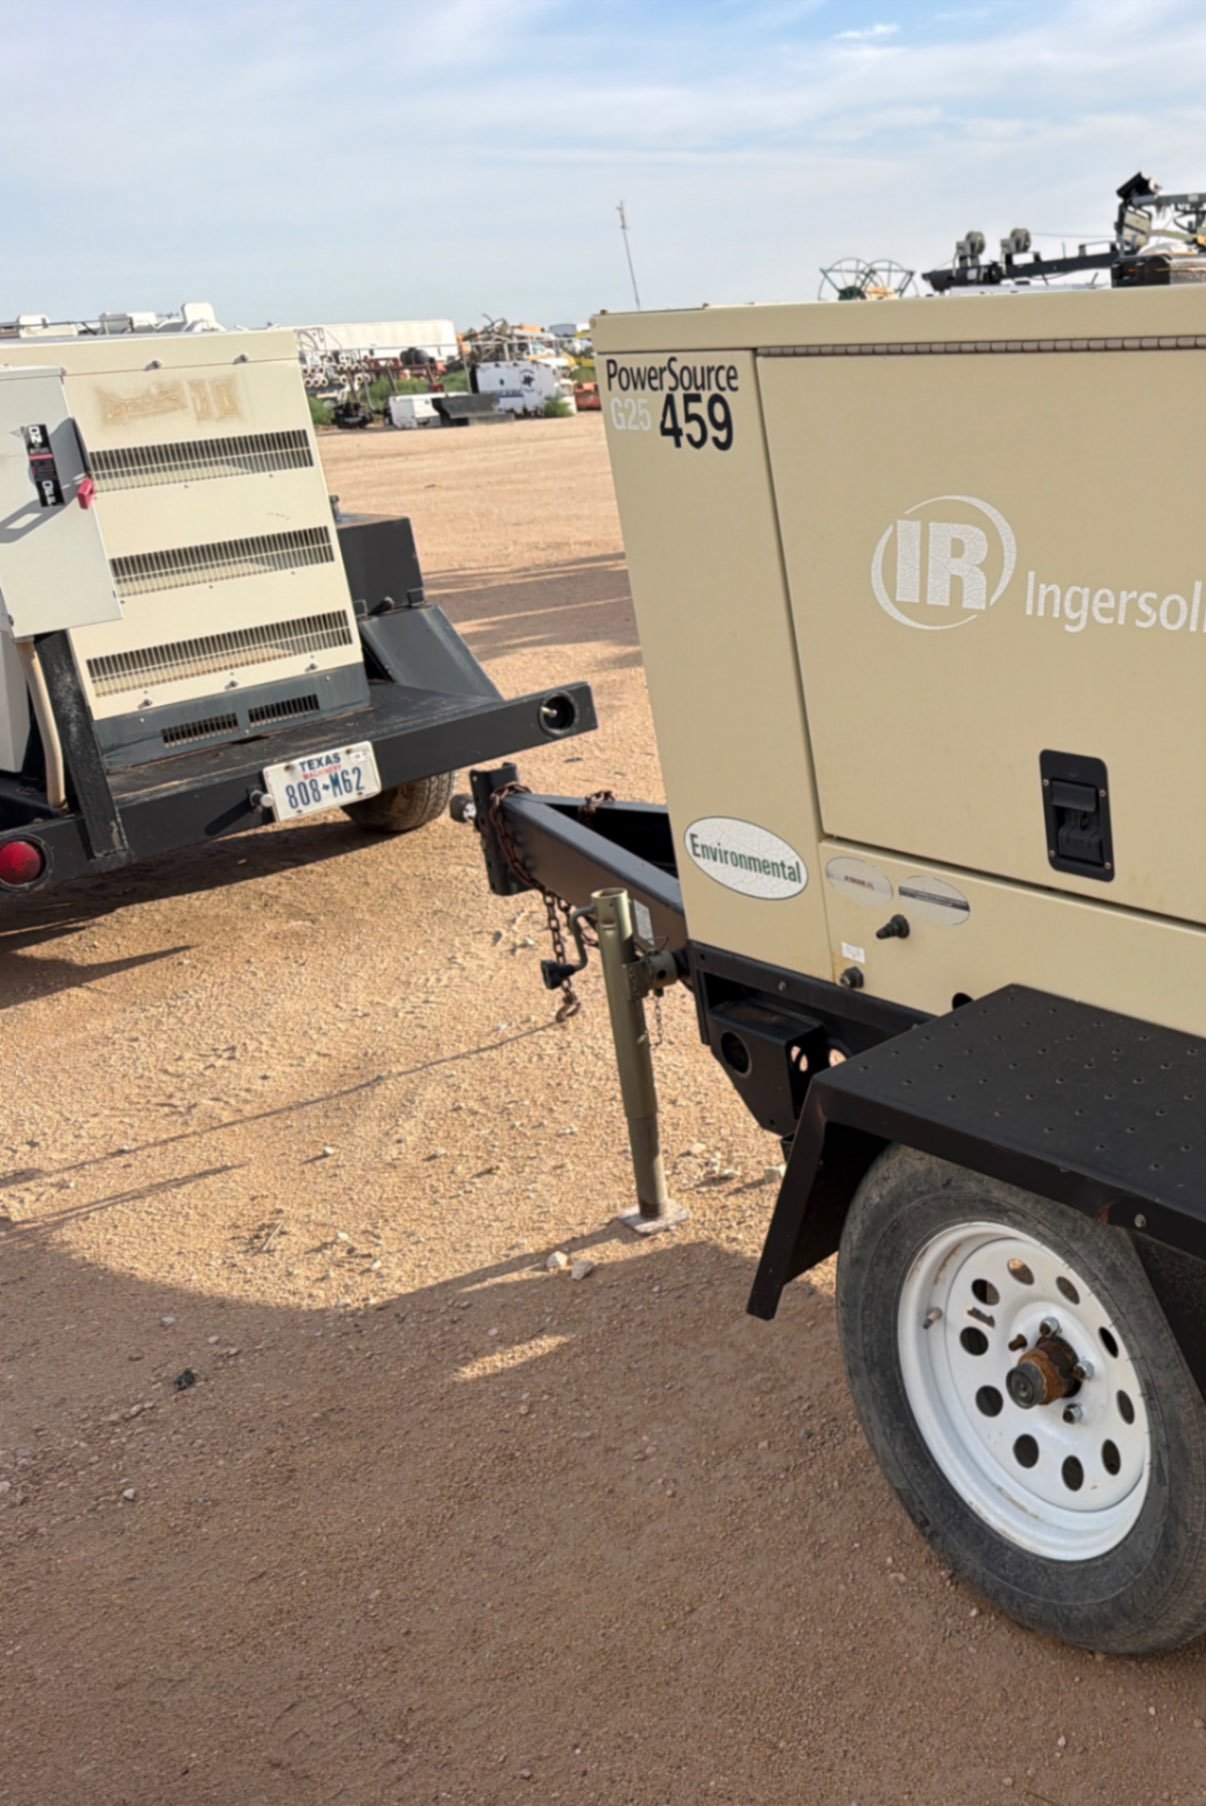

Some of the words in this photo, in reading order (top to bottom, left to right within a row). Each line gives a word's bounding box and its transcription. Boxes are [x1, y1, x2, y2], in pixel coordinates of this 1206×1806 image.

[605, 356, 739, 392] PowerSource
[610, 396, 652, 431] G25
[659, 392, 733, 451] 459
[895, 519, 988, 611] IR
[299, 753, 342, 772] TEXAS
[689, 833, 803, 884] Environmental
